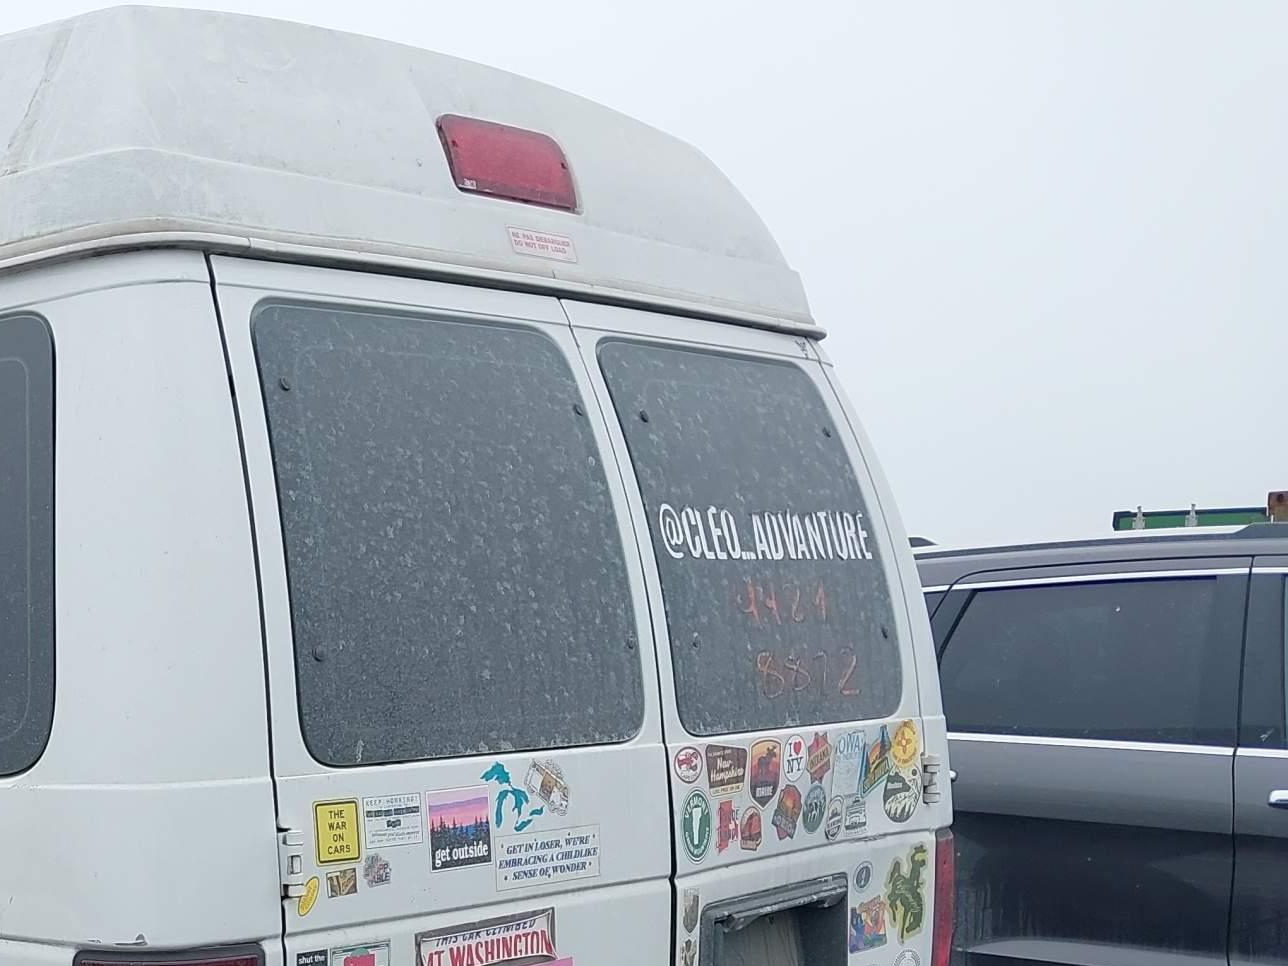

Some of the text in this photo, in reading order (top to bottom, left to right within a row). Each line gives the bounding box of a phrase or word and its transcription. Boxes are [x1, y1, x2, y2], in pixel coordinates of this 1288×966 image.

[789, 742, 793, 758] I
[717, 757, 732, 770] New
[786, 756, 804, 774] NY
[710, 767, 745, 783] Hampshire
[328, 809, 345, 820] THE
[327, 821, 347, 831] WAR
[332, 833, 344, 842] ON
[506, 835, 591, 855] GET IN LOSER, WE'RE
[327, 844, 351, 855] CARS
[434, 840, 489, 868] get outside
[498, 847, 599, 870] EMBRACING A CHILDLIKE
[512, 861, 588, 881] SENSE OF WONDER
[435, 935, 458, 947] THIS
[462, 931, 481, 942] CAR
[298, 954, 325, 965] shut the
